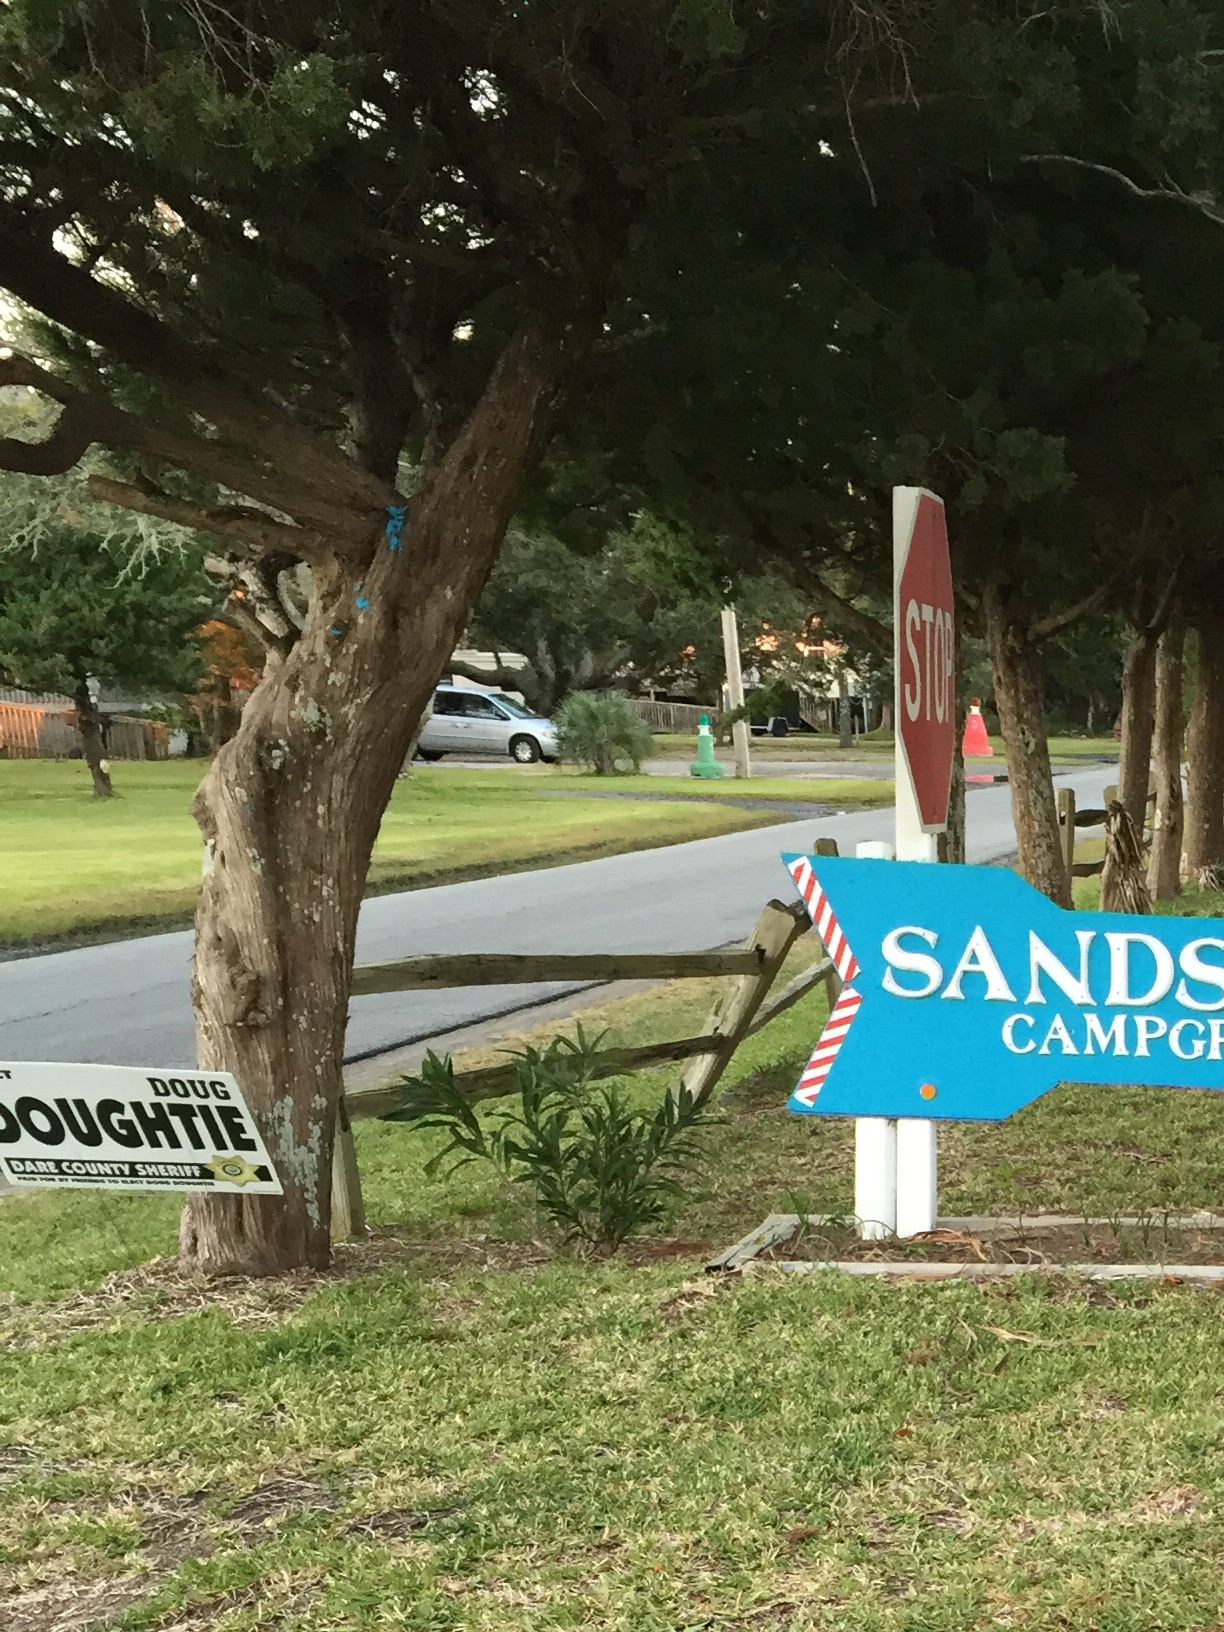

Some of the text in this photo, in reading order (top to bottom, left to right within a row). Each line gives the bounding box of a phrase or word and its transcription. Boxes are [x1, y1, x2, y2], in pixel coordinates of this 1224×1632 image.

[904, 599, 953, 724] STOP
[146, 1077, 231, 1100] DOUG
[10, 1160, 201, 1177] DARE COUNTY SHERIFF
